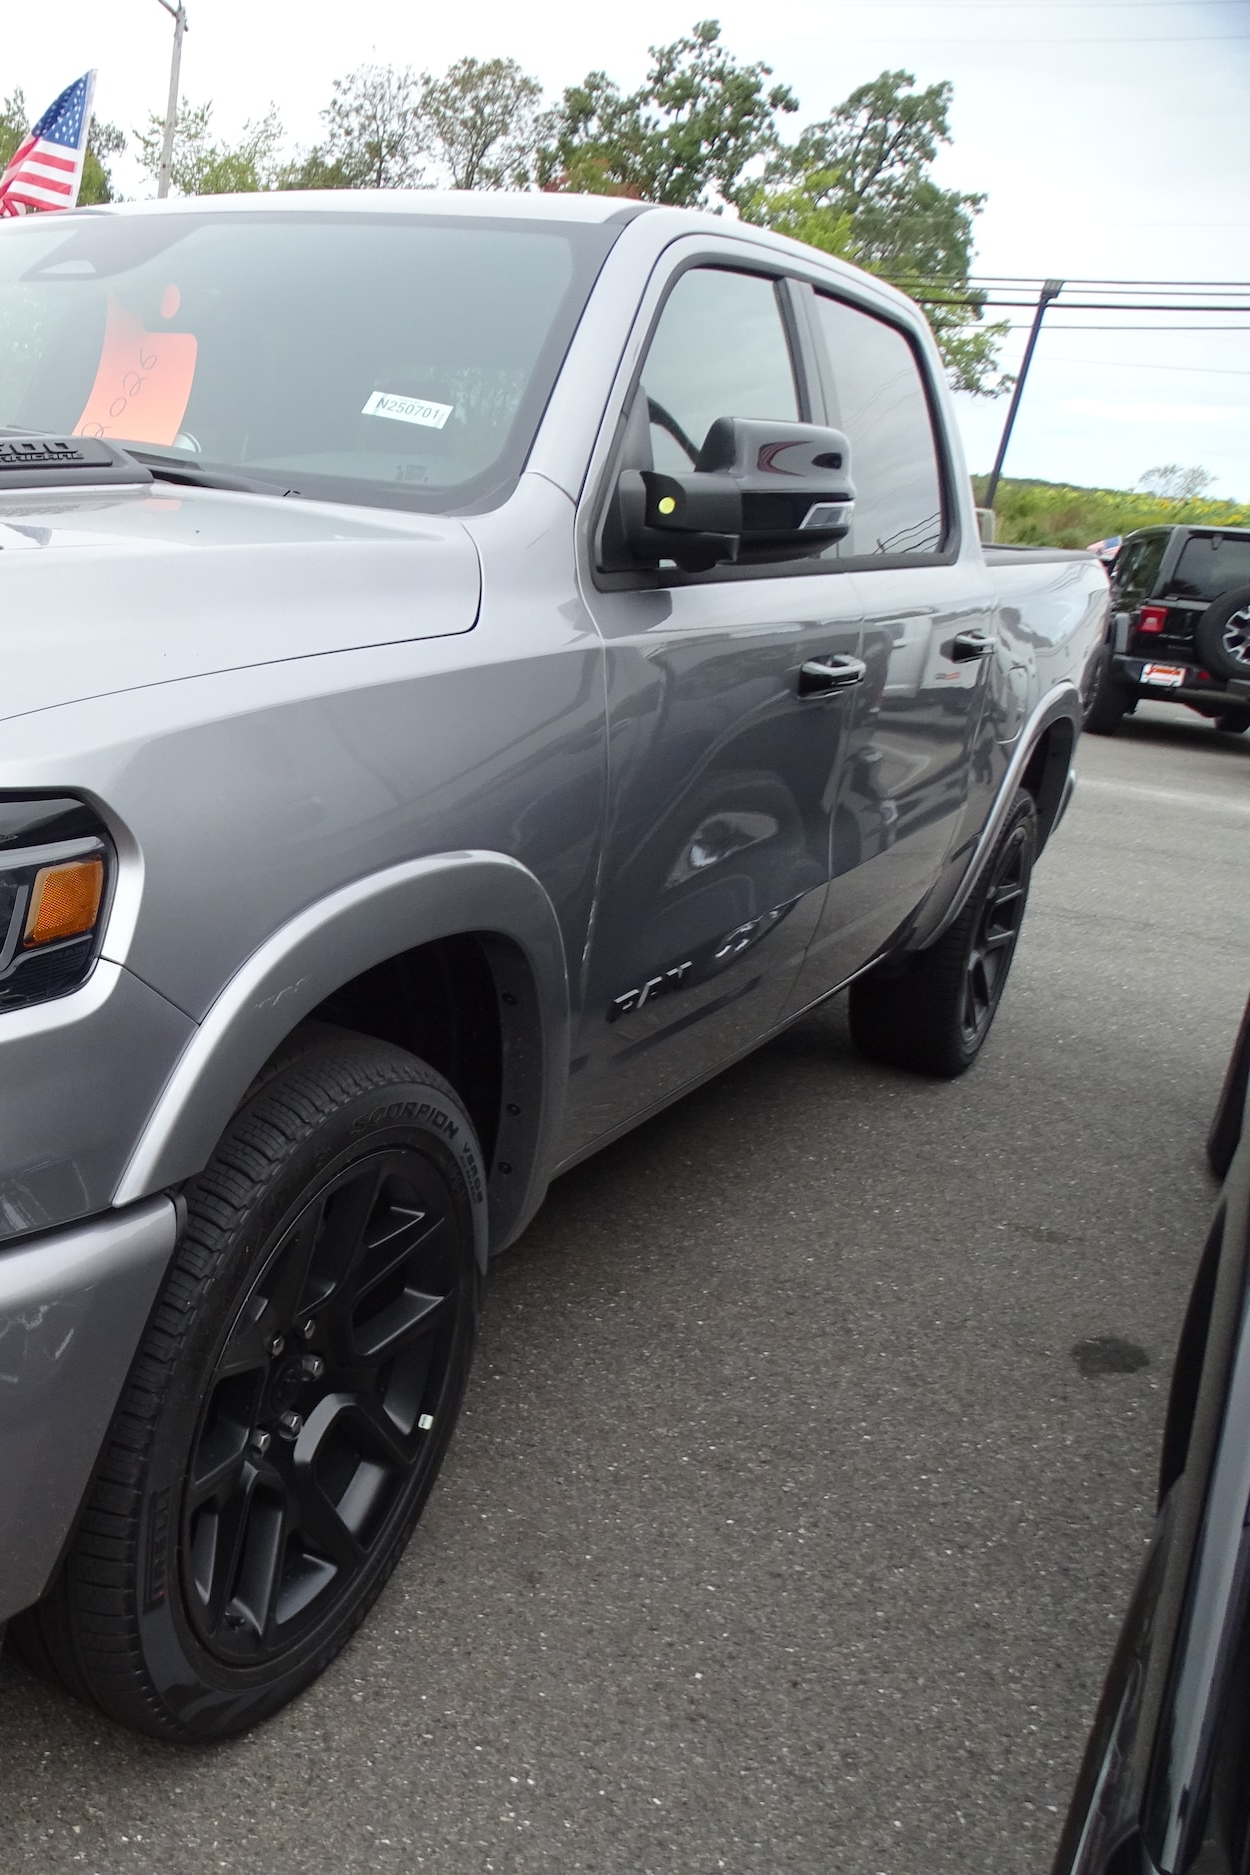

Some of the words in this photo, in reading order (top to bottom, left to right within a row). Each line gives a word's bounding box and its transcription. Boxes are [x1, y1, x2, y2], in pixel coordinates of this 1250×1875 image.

[80, 347, 158, 438] 2026
[376, 397, 440, 419] N250701
[350, 1101, 459, 1141] SCORPION
